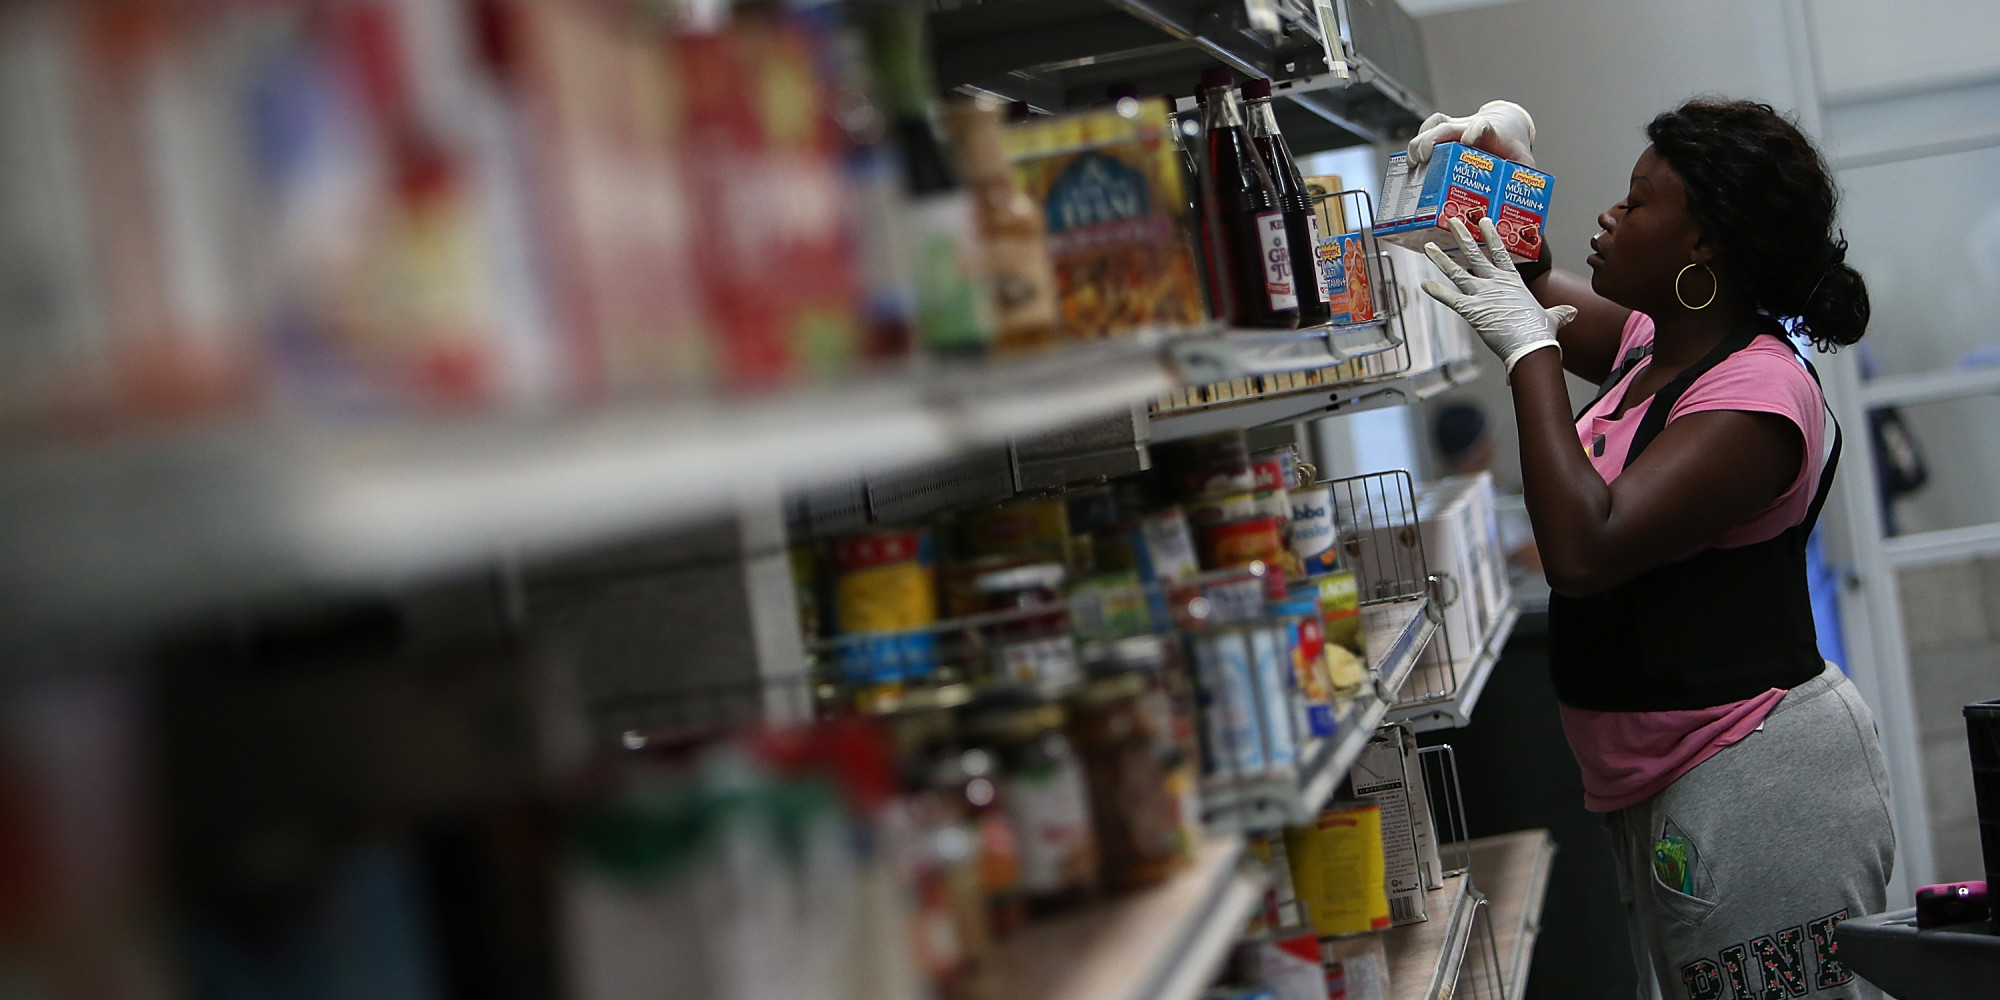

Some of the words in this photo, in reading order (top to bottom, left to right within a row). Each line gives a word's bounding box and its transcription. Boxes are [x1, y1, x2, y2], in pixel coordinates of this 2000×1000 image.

[1461, 154, 1493, 170] Emergen-C
[1453, 164, 1479, 180] MULTI
[1513, 172, 1544, 188] Emergen-C
[1505, 182, 1531, 198] MULTI
[1322, 246, 1340, 258] mergen-C
